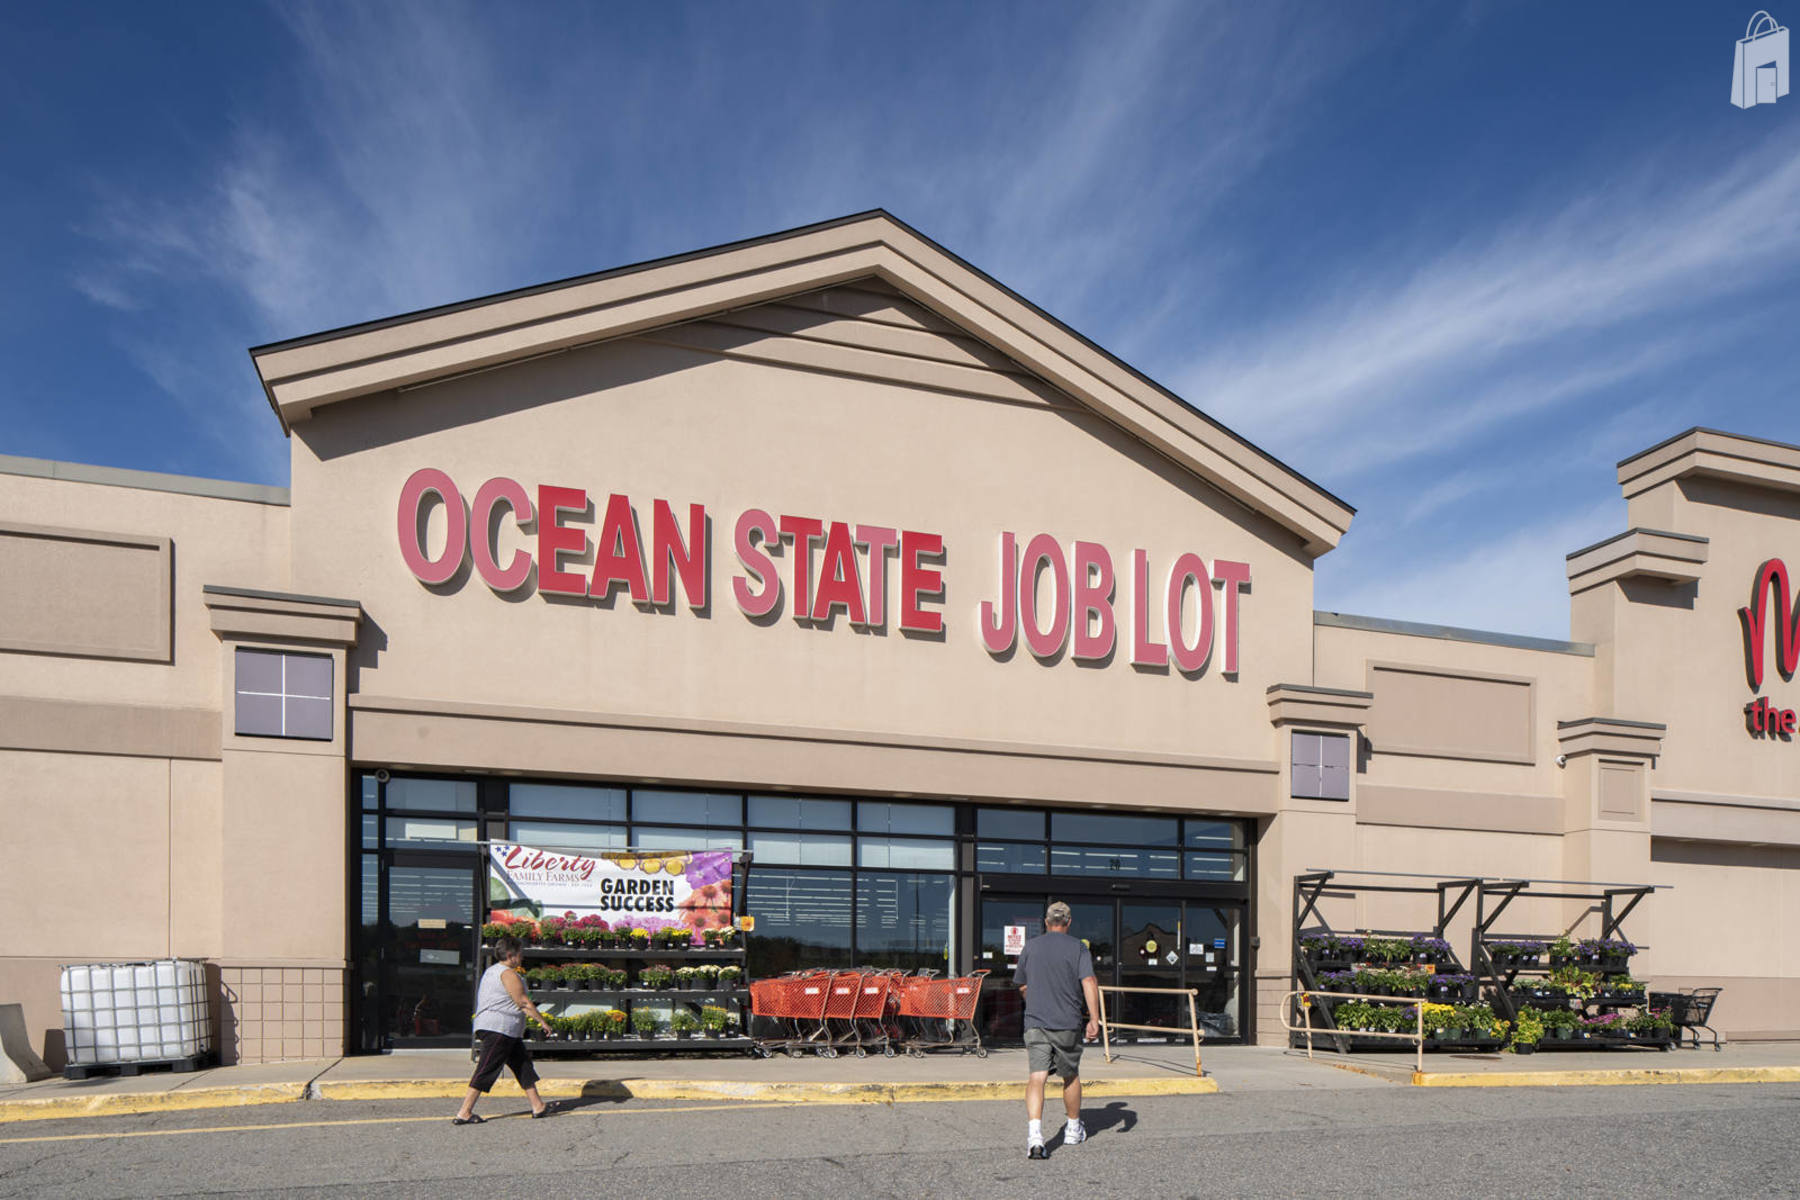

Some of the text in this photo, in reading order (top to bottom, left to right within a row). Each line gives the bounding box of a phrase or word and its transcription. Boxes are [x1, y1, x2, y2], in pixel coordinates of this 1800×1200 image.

[397, 467, 1251, 674] OCEAN STATE JOB LOT
[1748, 696, 1797, 736] the
[504, 845, 596, 881] Liberty
[545, 871, 581, 883] FARMS
[600, 878, 675, 896] GARDEN
[600, 895, 675, 912] SUCCESS
